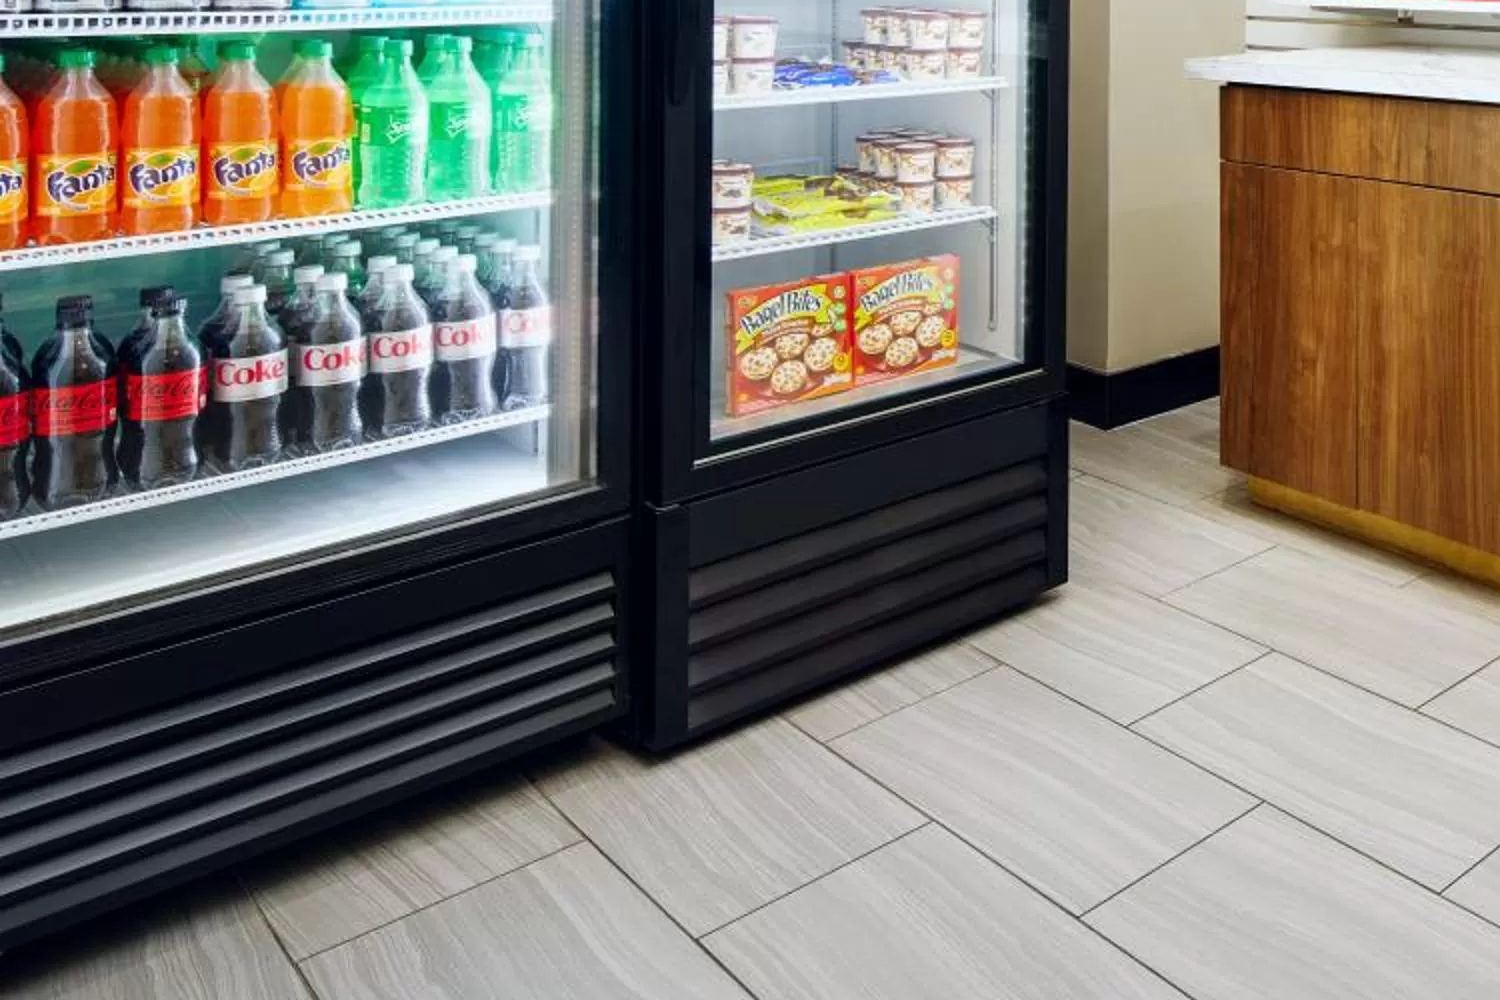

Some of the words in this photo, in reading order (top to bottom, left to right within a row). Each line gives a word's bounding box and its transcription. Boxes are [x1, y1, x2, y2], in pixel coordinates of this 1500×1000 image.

[740, 292, 786, 335] Bagel
[787, 289, 823, 312] Bites
[860, 275, 901, 313] Bagel
[901, 271, 934, 294] Bites
[214, 358, 286, 388] Coke
